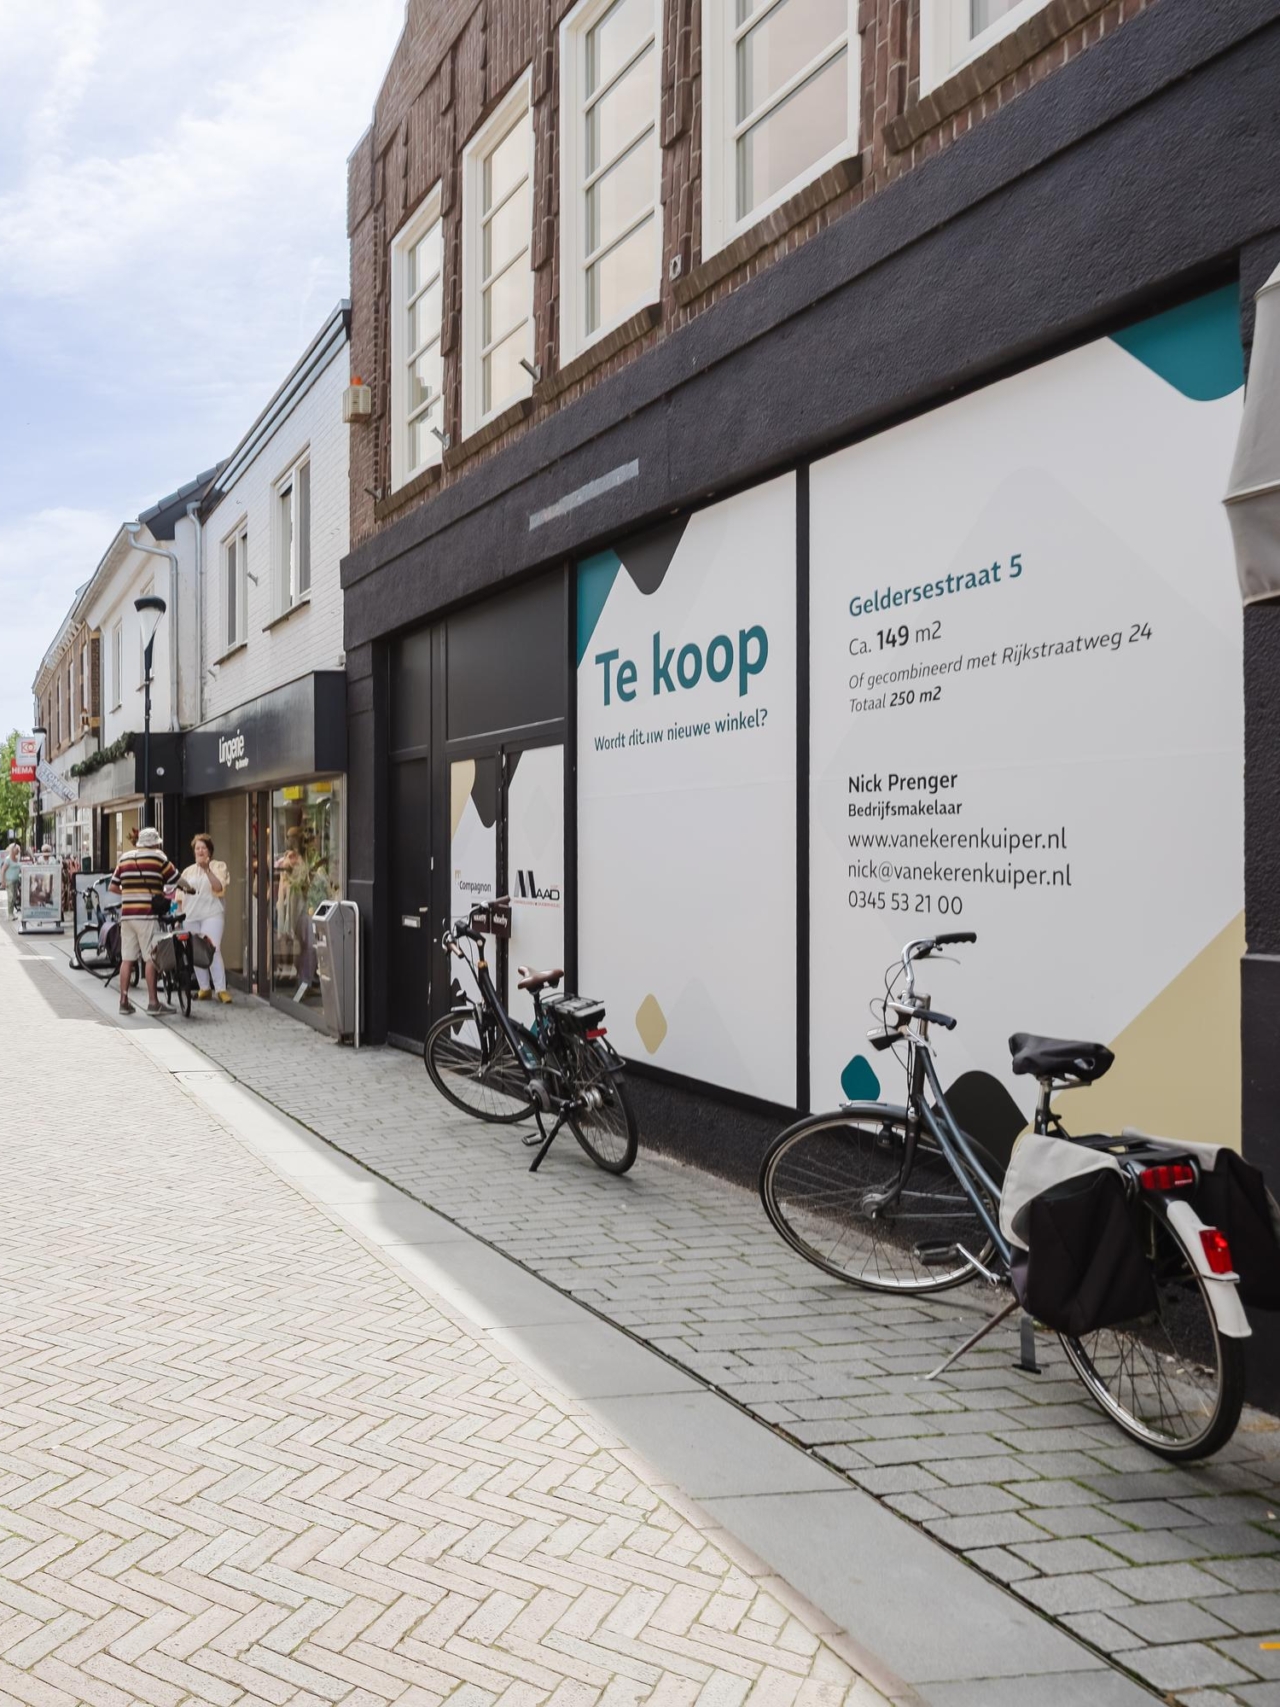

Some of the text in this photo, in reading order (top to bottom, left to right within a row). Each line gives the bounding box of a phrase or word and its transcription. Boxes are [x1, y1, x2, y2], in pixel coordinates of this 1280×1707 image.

[849, 553, 1023, 617] Geldersestraat 5
[849, 620, 942, 656] Ca. 149 m2
[595, 624, 769, 706] Te koop
[849, 622, 1153, 690] Of gecombineerd met Rijkstraatweg 24
[850, 685, 942, 713] Totaal 250 m2
[594, 731, 626, 751] Wordt
[628, 729, 645, 746] dit
[667, 722, 711, 740] nieuwe
[715, 708, 768, 733] winkel?
[848, 772, 958, 794] Nick Prenger
[848, 799, 962, 820] Bedrijfsmakelaar
[848, 826, 1067, 854] www.vanekerenkuiper.nl
[460, 880, 492, 894] Compagnon
[848, 859, 1072, 889] nick@vanekerenkuiper.nl
[848, 890, 963, 915] 0345 53 21 00
